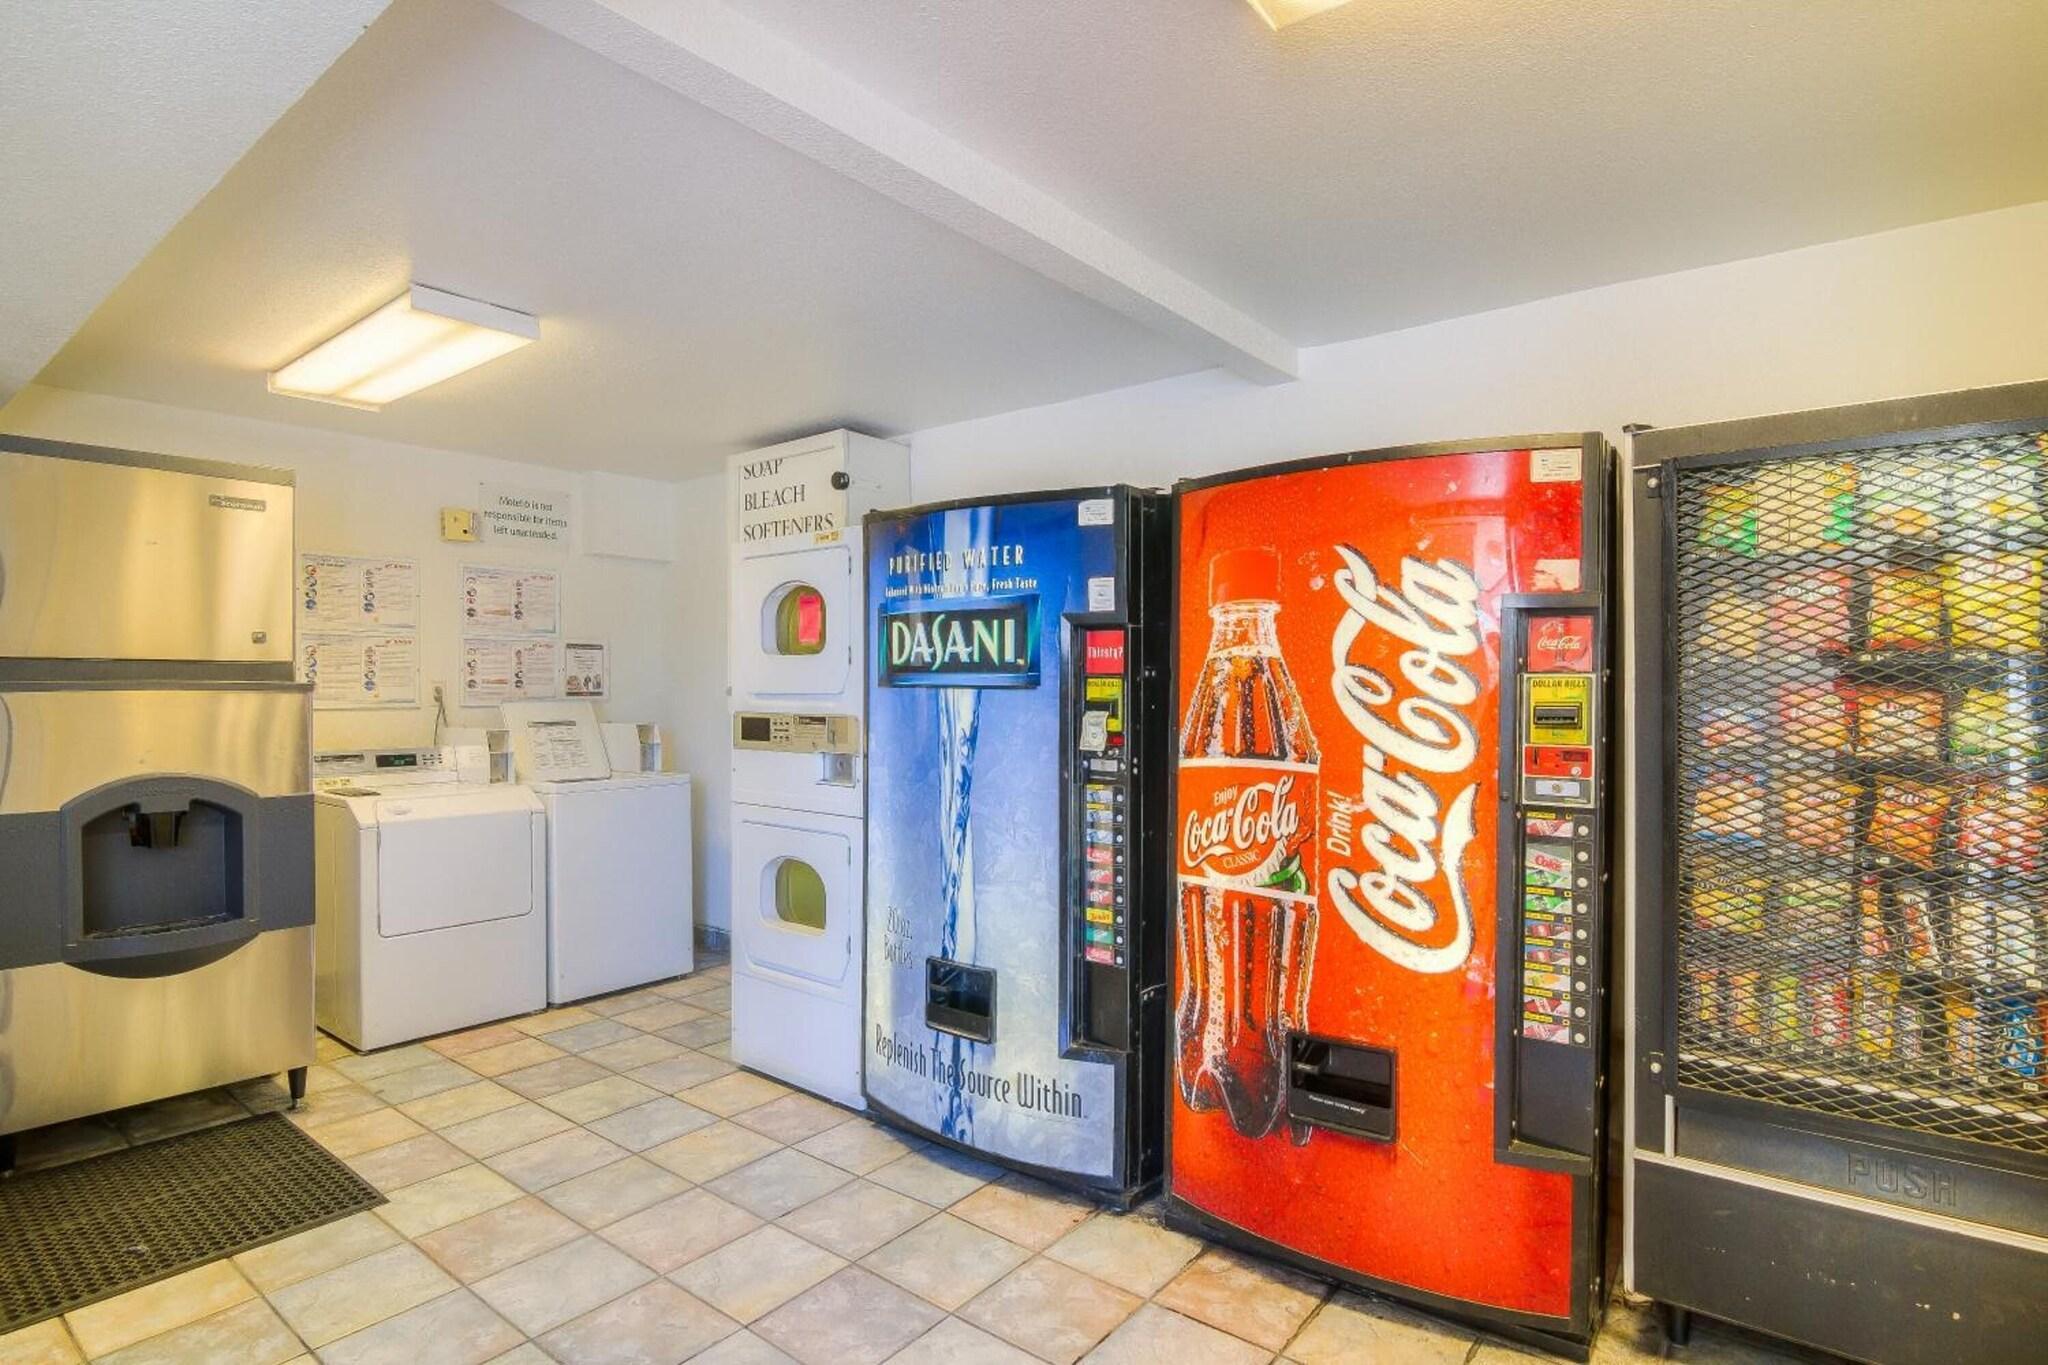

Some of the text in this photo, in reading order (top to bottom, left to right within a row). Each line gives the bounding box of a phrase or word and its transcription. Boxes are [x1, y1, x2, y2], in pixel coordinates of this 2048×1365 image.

[744, 458, 783, 480] SOAP
[745, 484, 805, 511] BLEACH
[744, 513, 834, 542] SOFTENERS
[889, 544, 1024, 575] PURIFIED WATER
[992, 577, 1013, 590] Fresh
[1015, 575, 1037, 589] Taste
[892, 613, 1017, 671] DASANI
[1328, 544, 1482, 974] Coca-Cola
[1214, 785, 1238, 806] Enjoy
[1183, 775, 1300, 868] Coca-Cola
[1222, 849, 1262, 869] CLASSIC
[875, 1023, 1082, 1119] Replenish The Source Within
[1847, 1152, 1956, 1207] PUSH
